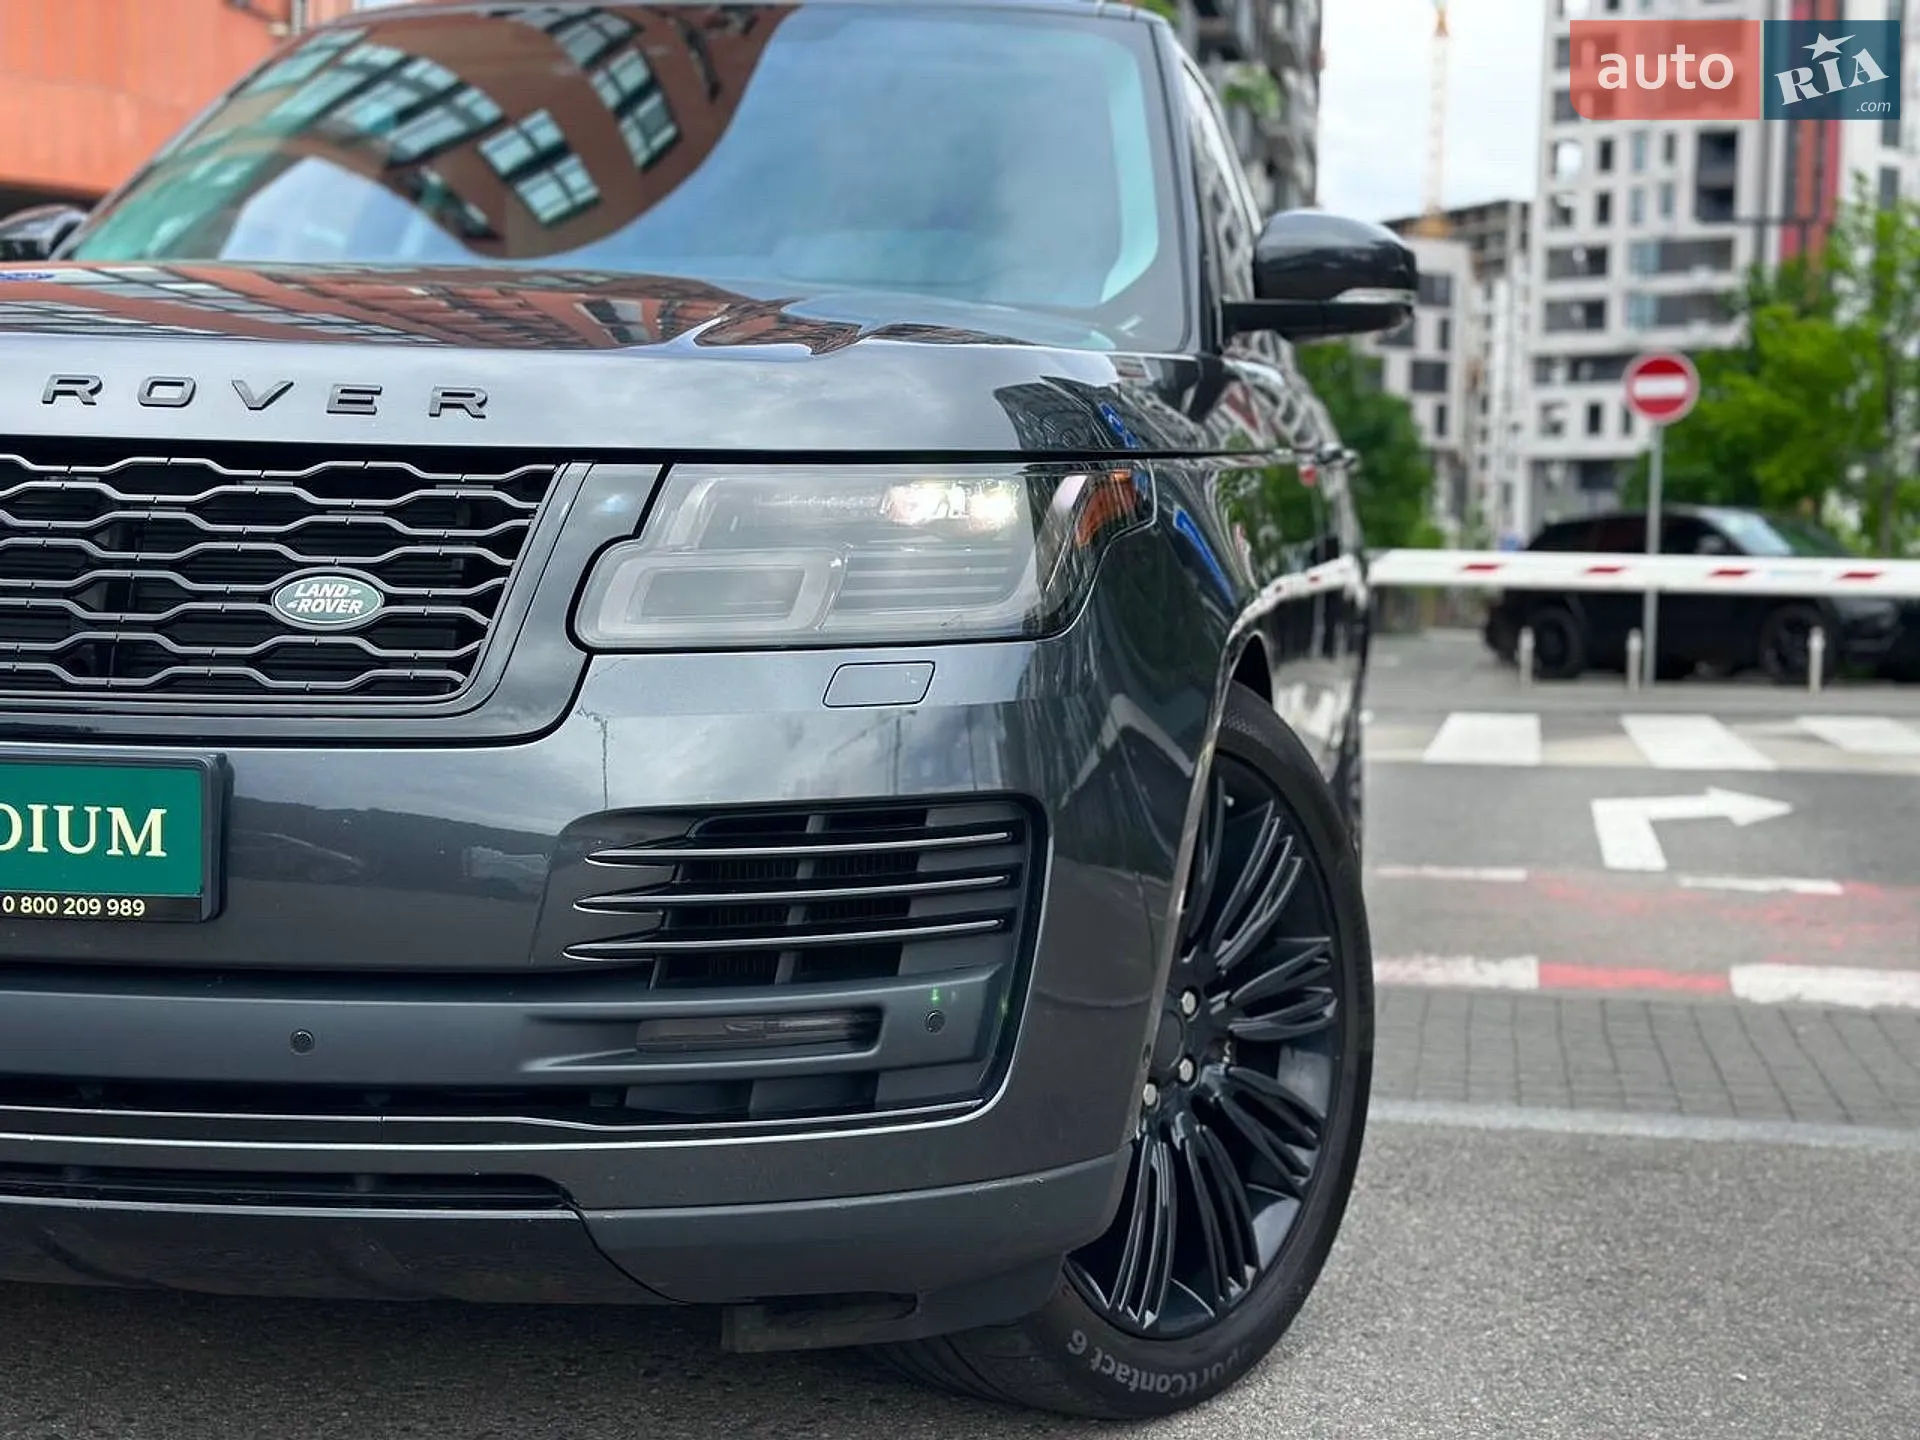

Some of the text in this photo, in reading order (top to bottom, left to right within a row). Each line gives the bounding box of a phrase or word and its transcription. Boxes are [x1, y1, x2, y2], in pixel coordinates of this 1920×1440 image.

[41, 372, 490, 420] ROVER
[294, 583, 350, 598] LAND
[296, 598, 364, 615] ROVER
[2, 895, 146, 917] 0 800 209 989
[1066, 1328, 1088, 1356] 6
